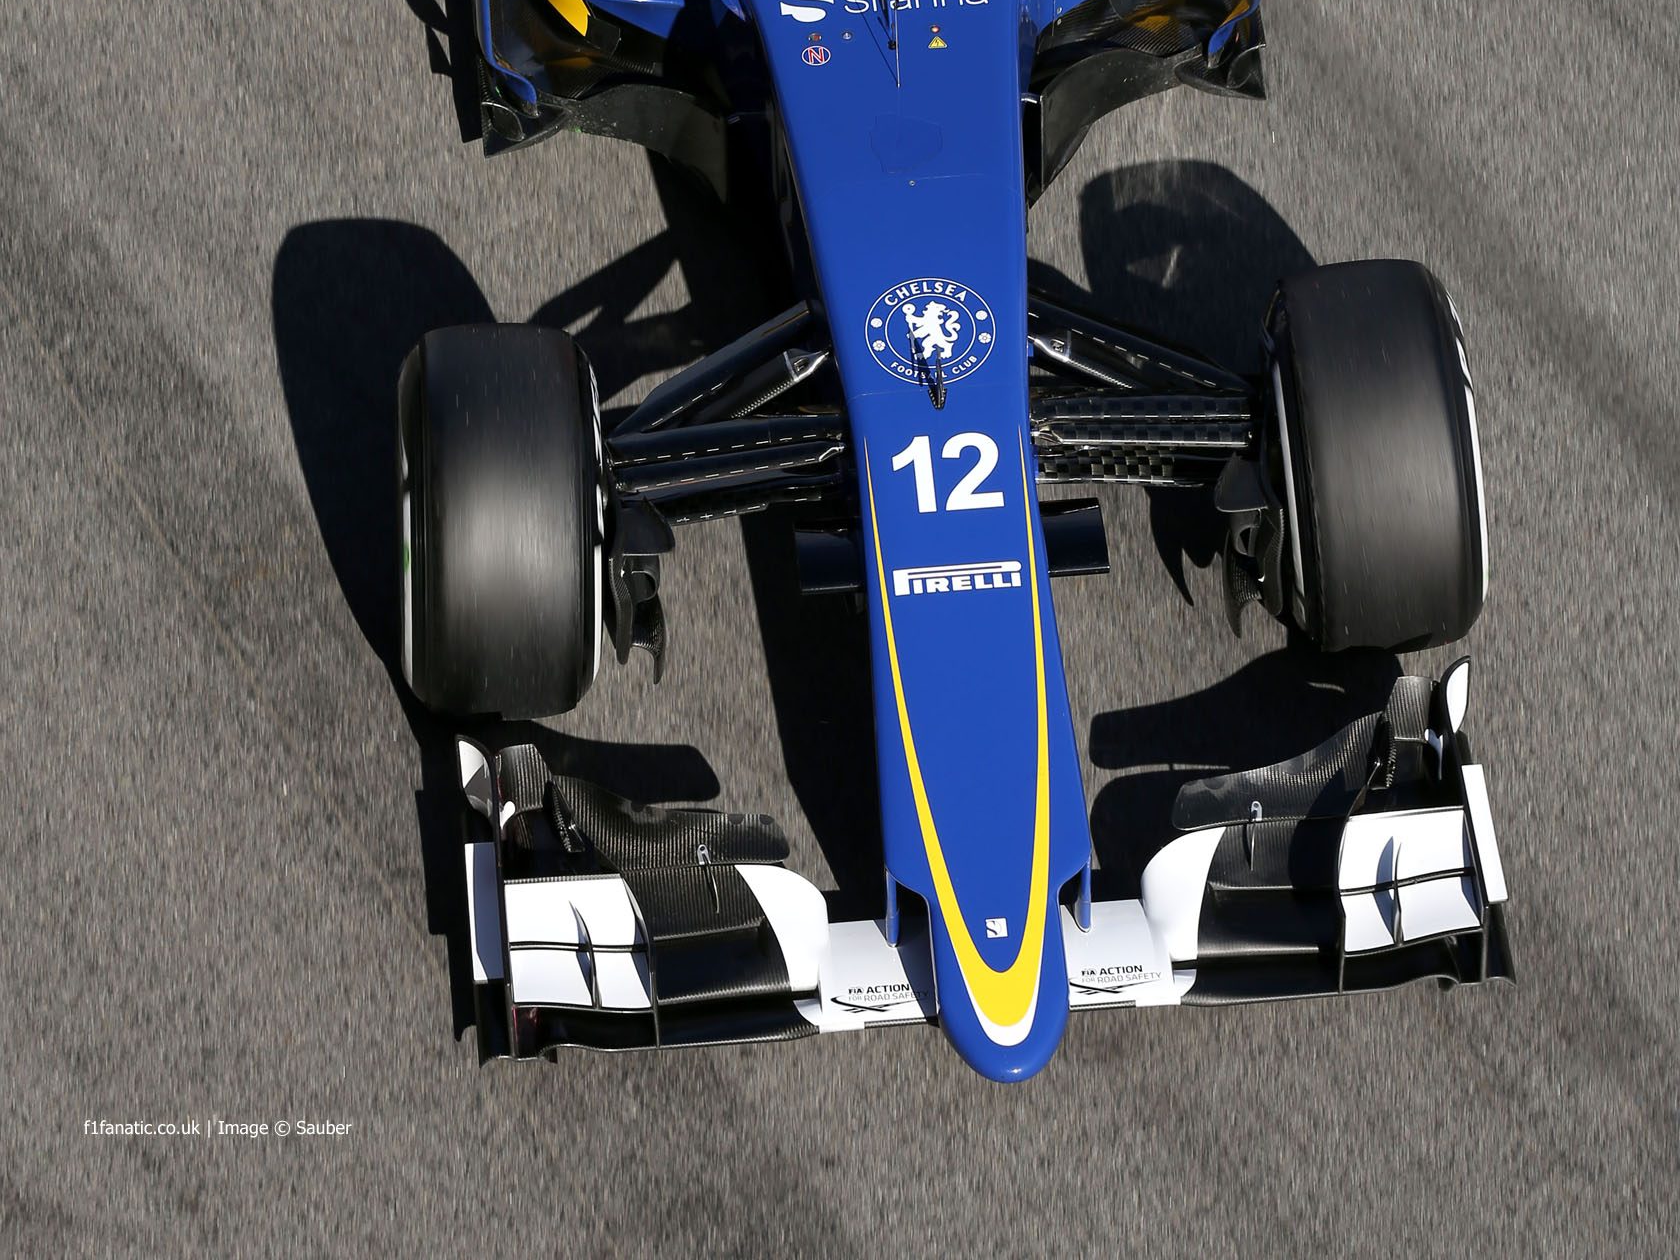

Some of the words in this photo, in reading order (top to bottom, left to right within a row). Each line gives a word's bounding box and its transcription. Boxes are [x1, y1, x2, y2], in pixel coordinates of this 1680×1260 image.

[884, 281, 967, 306] CHELSEA
[952, 355, 978, 374] CLUB
[891, 432, 1005, 514] 12
[892, 560, 1022, 597] PIRELLI
[1099, 964, 1143, 976] ACTION
[1097, 975, 1124, 984] ROAD
[1125, 972, 1162, 982] SAFETY
[866, 983, 910, 994] ACTION
[863, 993, 890, 1002] ROAD
